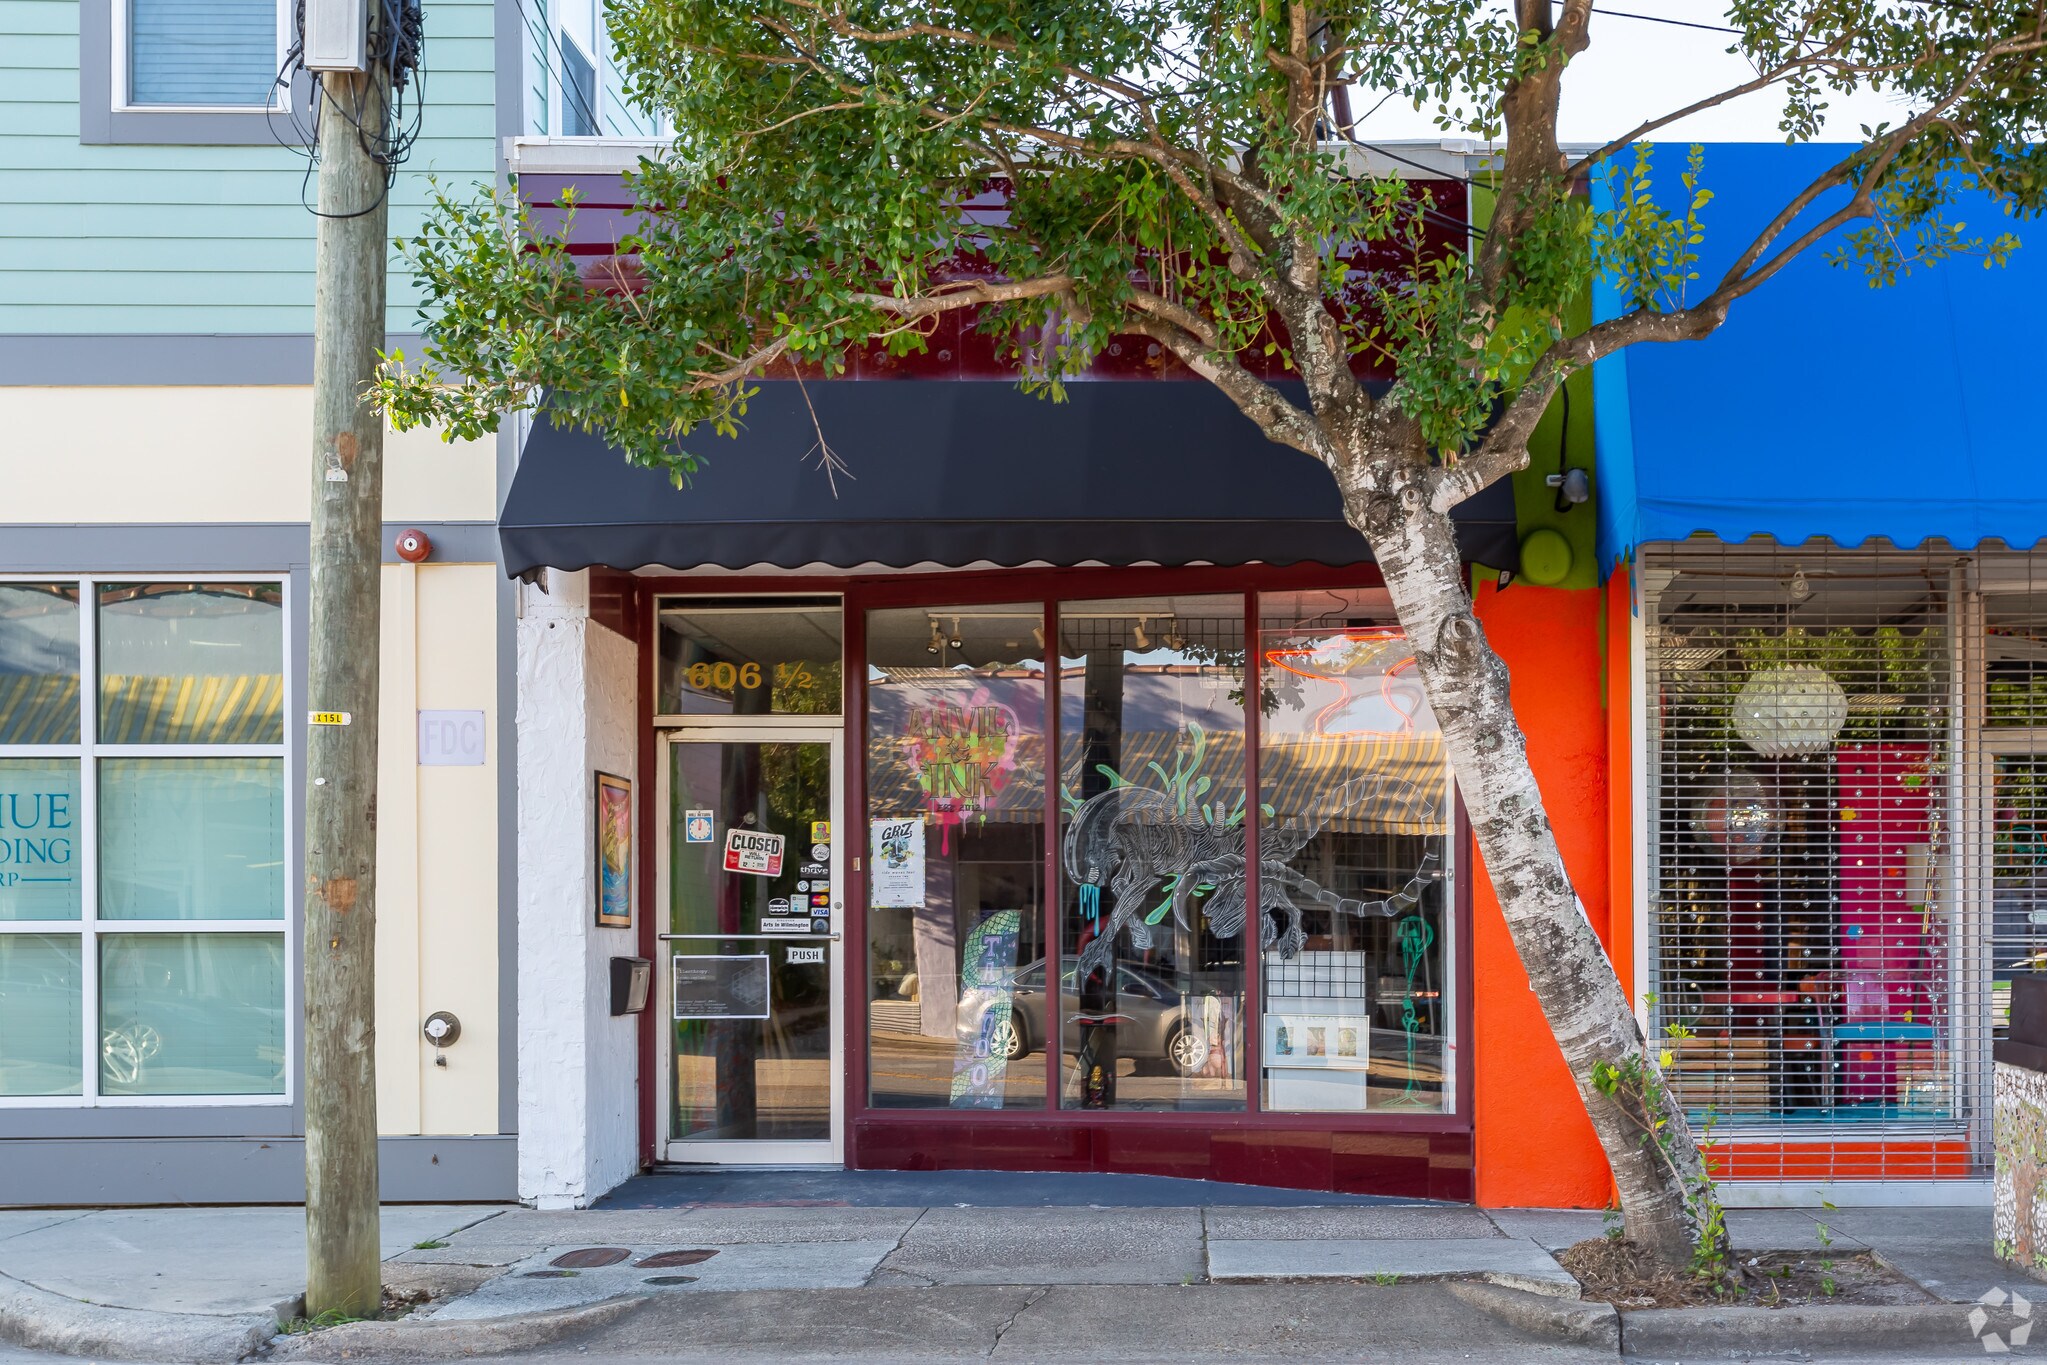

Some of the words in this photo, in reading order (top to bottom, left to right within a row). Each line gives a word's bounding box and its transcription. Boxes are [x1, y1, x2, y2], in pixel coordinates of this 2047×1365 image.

[688, 662, 762, 690] 606
[424, 719, 478, 755] FDC
[906, 706, 1012, 740] ANVIL
[929, 761, 998, 798] INK
[731, 834, 780, 855] CLOSED
[800, 865, 829, 874] thrive
[792, 951, 819, 960] PUSH
